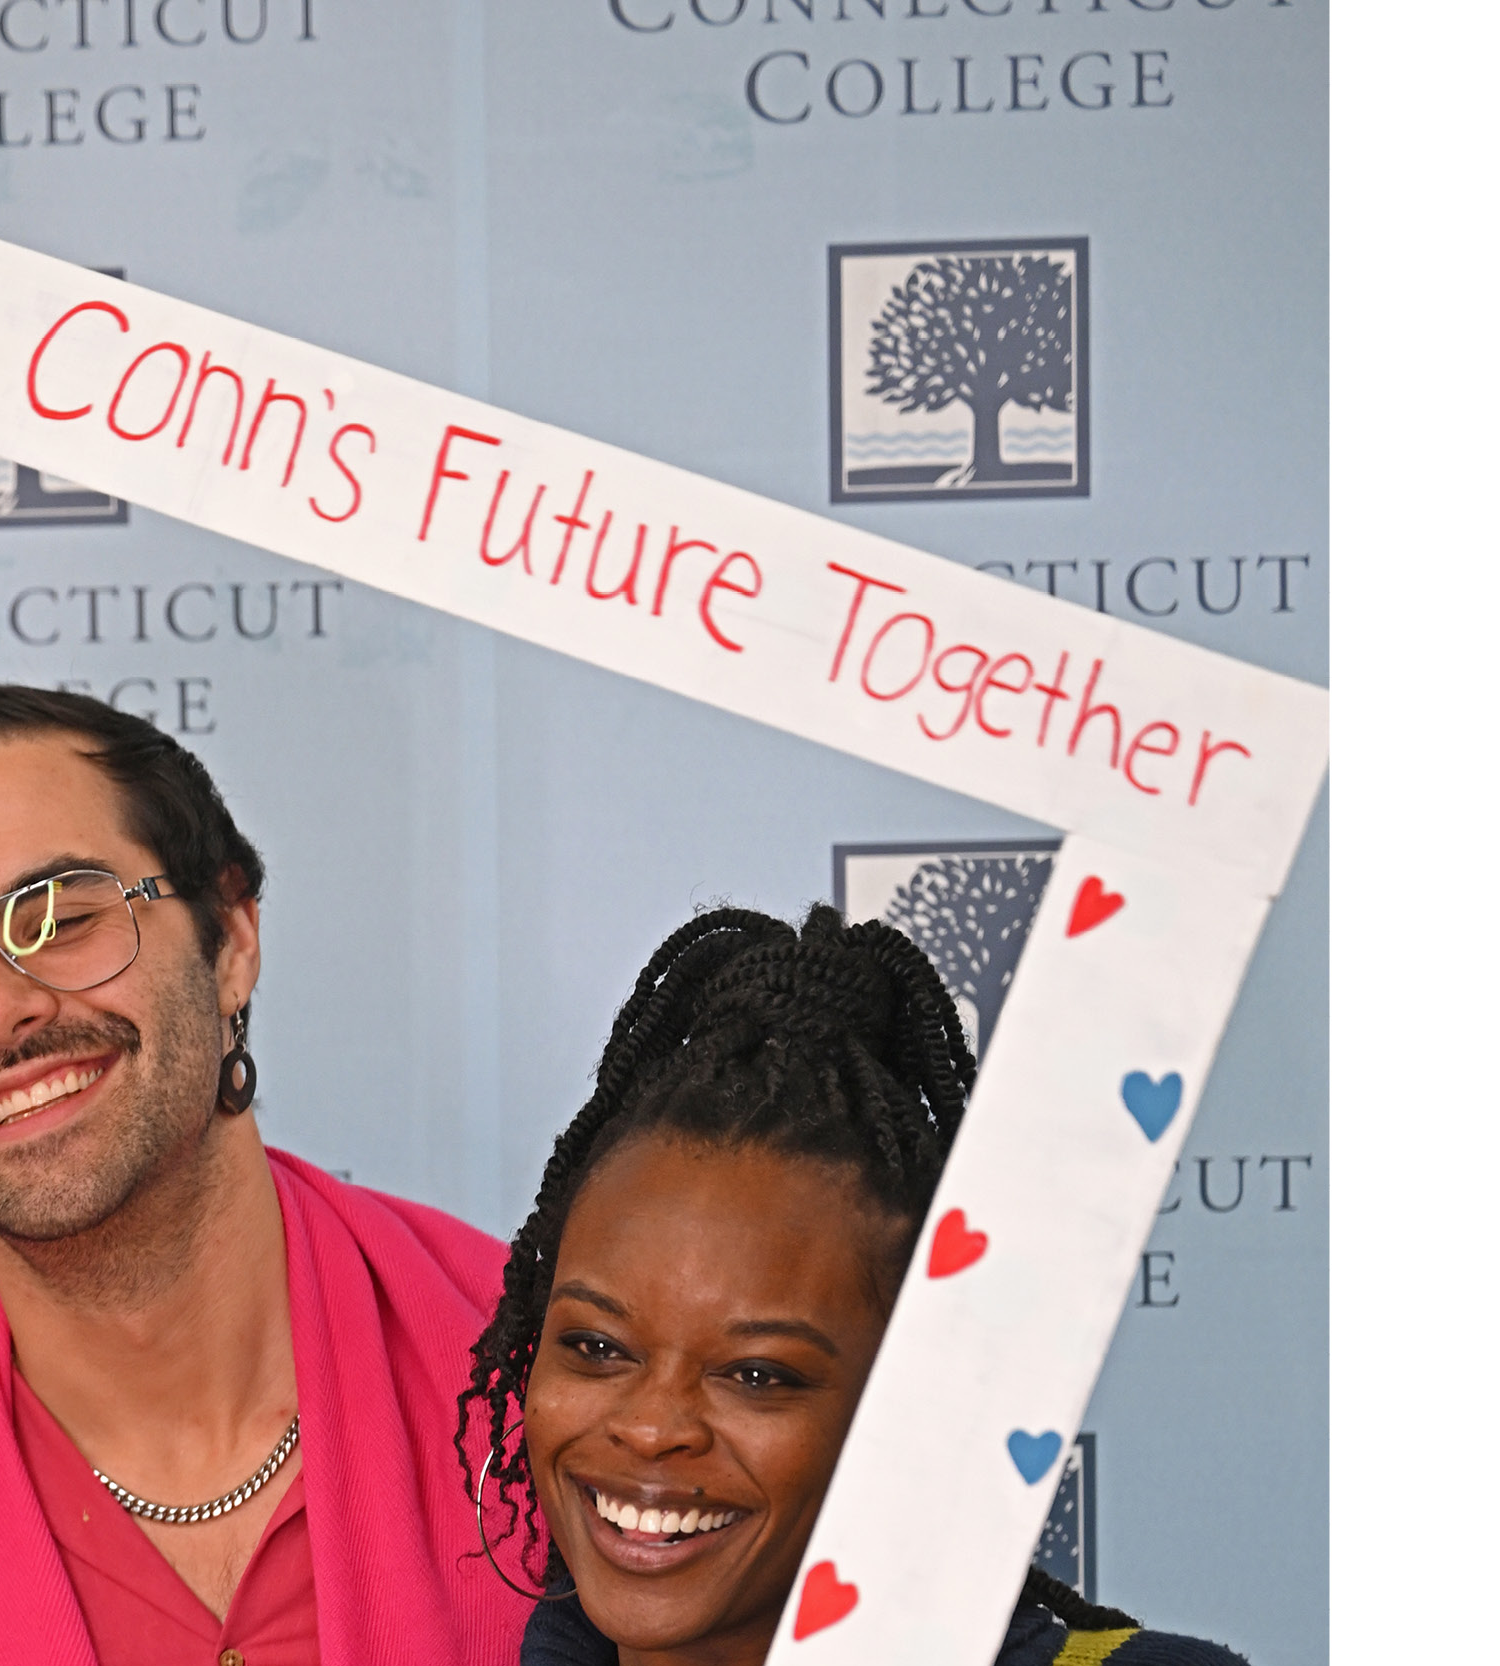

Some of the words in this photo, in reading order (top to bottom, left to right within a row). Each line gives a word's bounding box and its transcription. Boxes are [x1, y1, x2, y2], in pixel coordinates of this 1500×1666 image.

[743, 48, 1177, 126] COLLEGE
[25, 300, 377, 523] Conn's
[416, 424, 764, 655] Future
[825, 560, 1252, 807] Together
